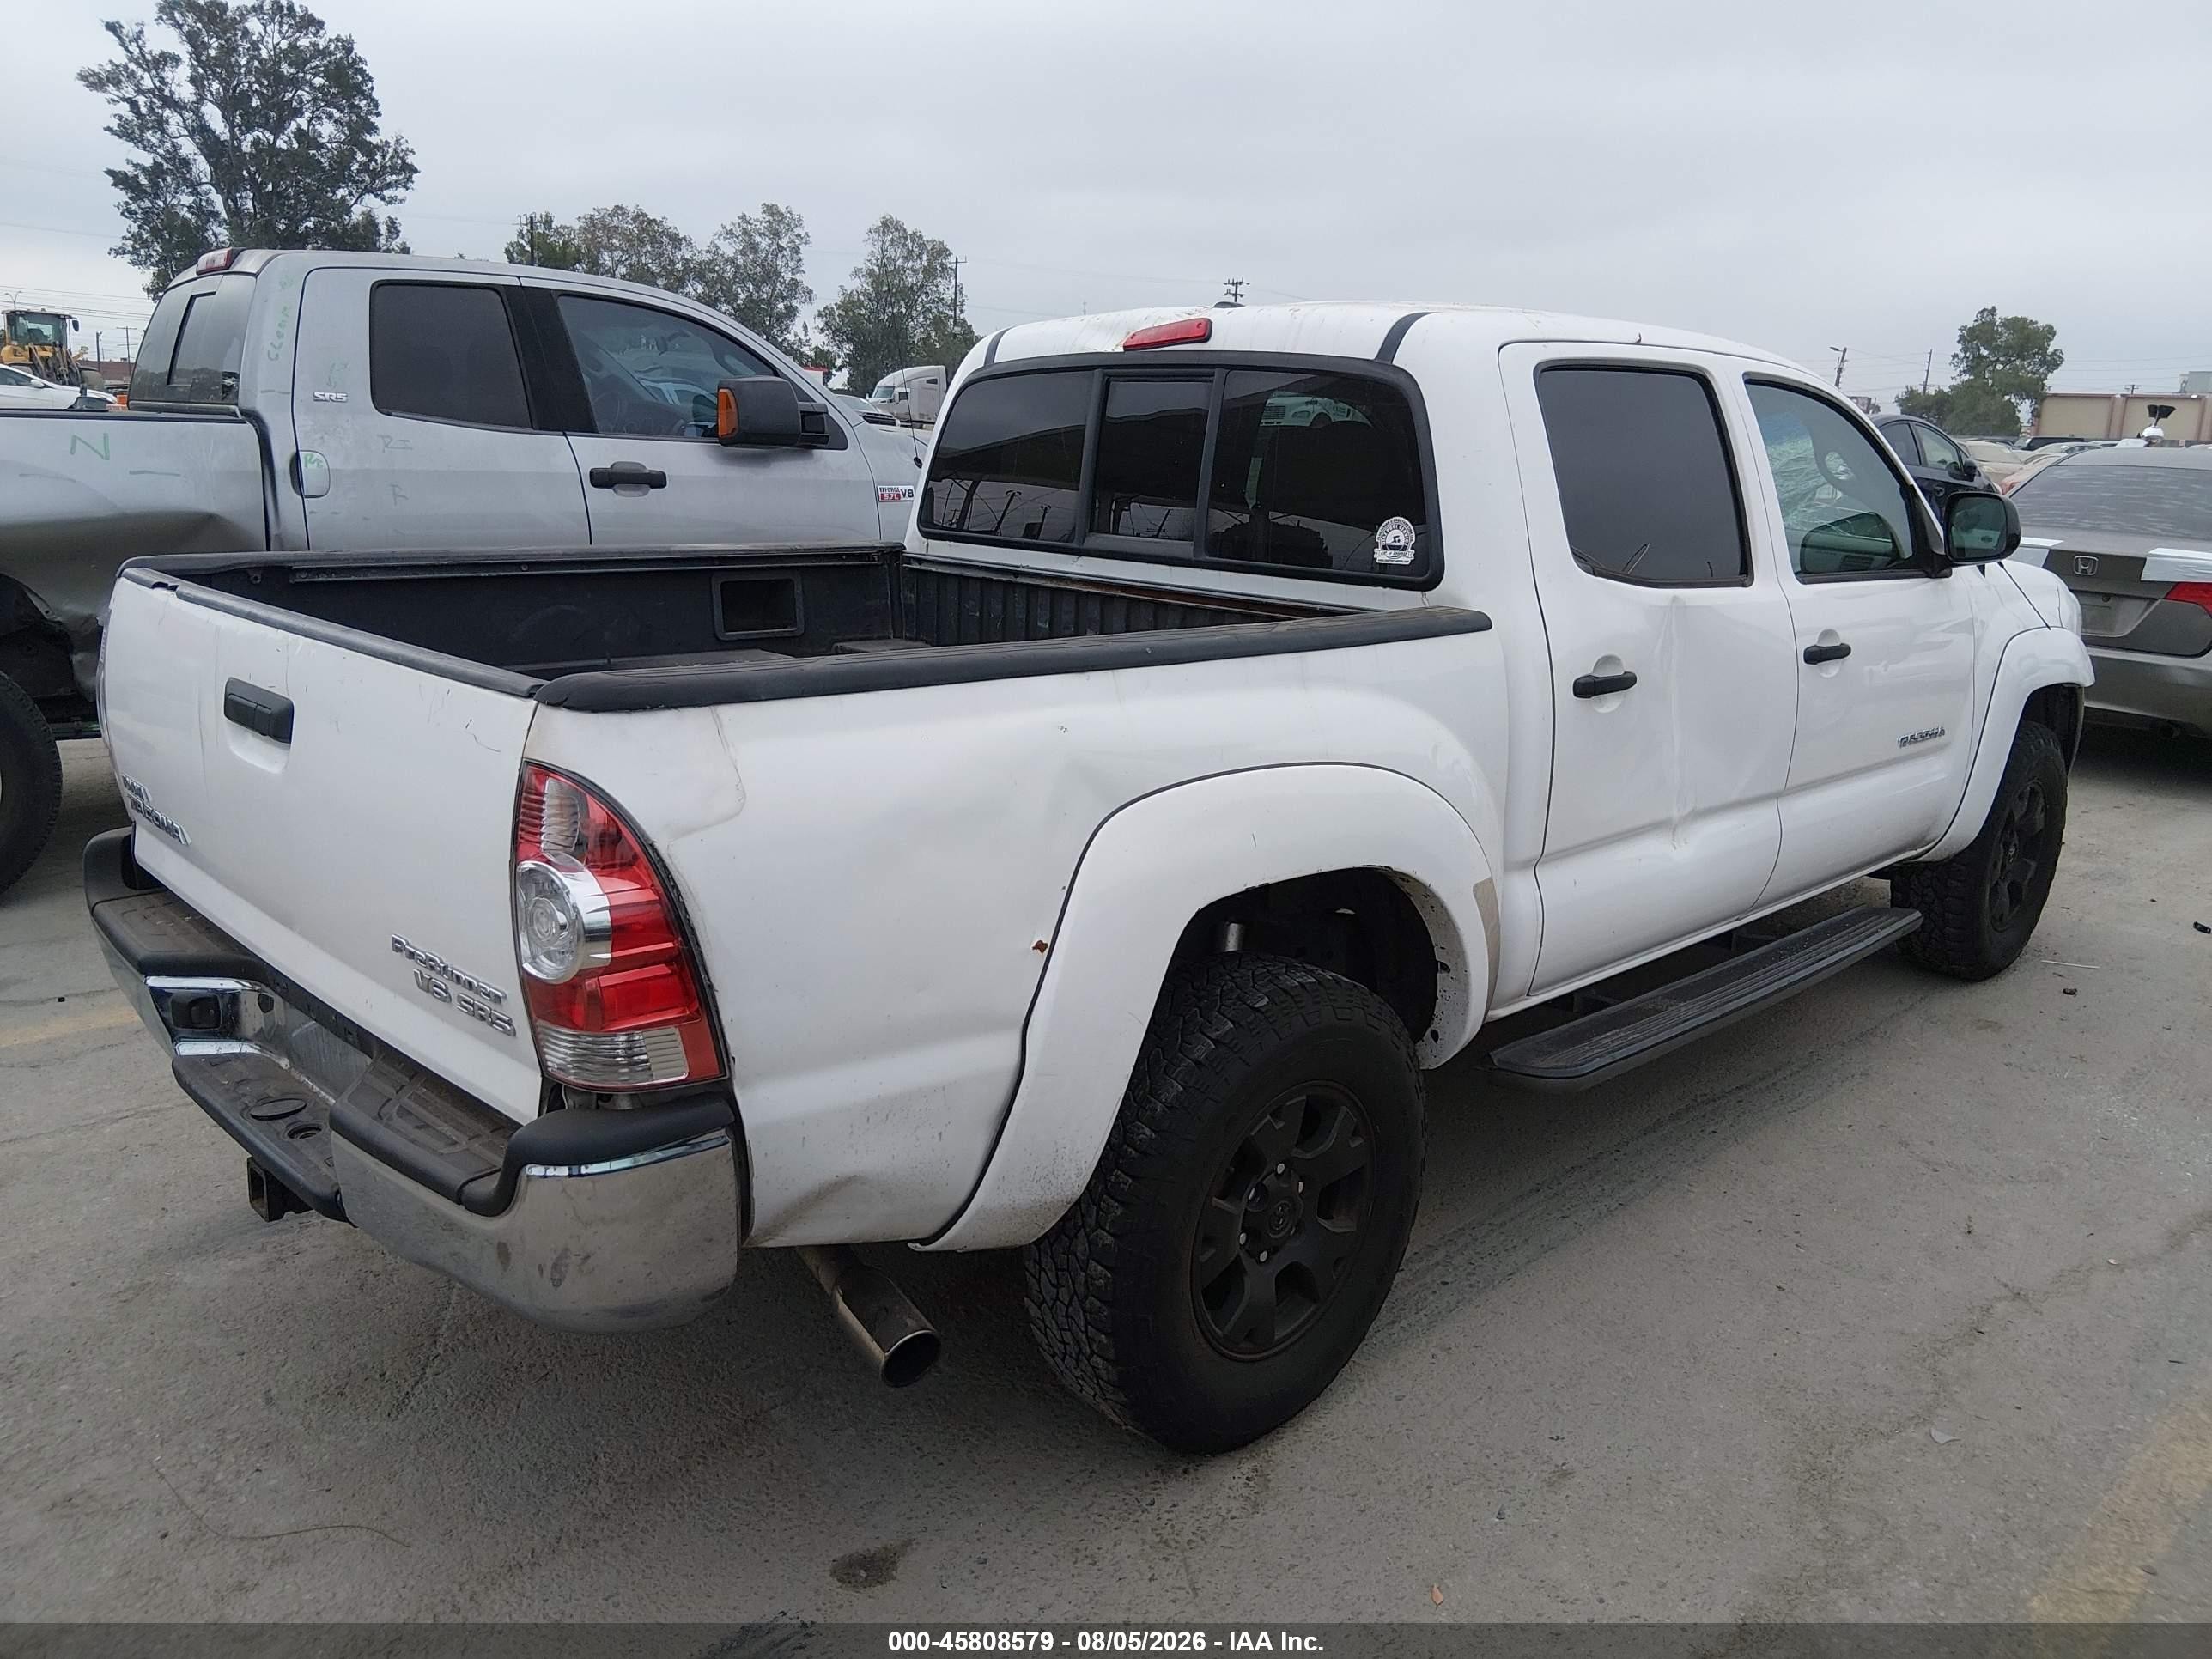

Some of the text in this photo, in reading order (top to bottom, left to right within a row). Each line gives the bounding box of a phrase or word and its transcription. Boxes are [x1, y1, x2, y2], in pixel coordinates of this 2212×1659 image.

[313, 392, 348, 403] SR5
[70, 432, 110, 461] N
[901, 489, 914, 499] V8
[127, 792, 191, 846] TACOMA
[391, 933, 507, 1004] PreRunner
[413, 968, 517, 1036] V6 SR5
